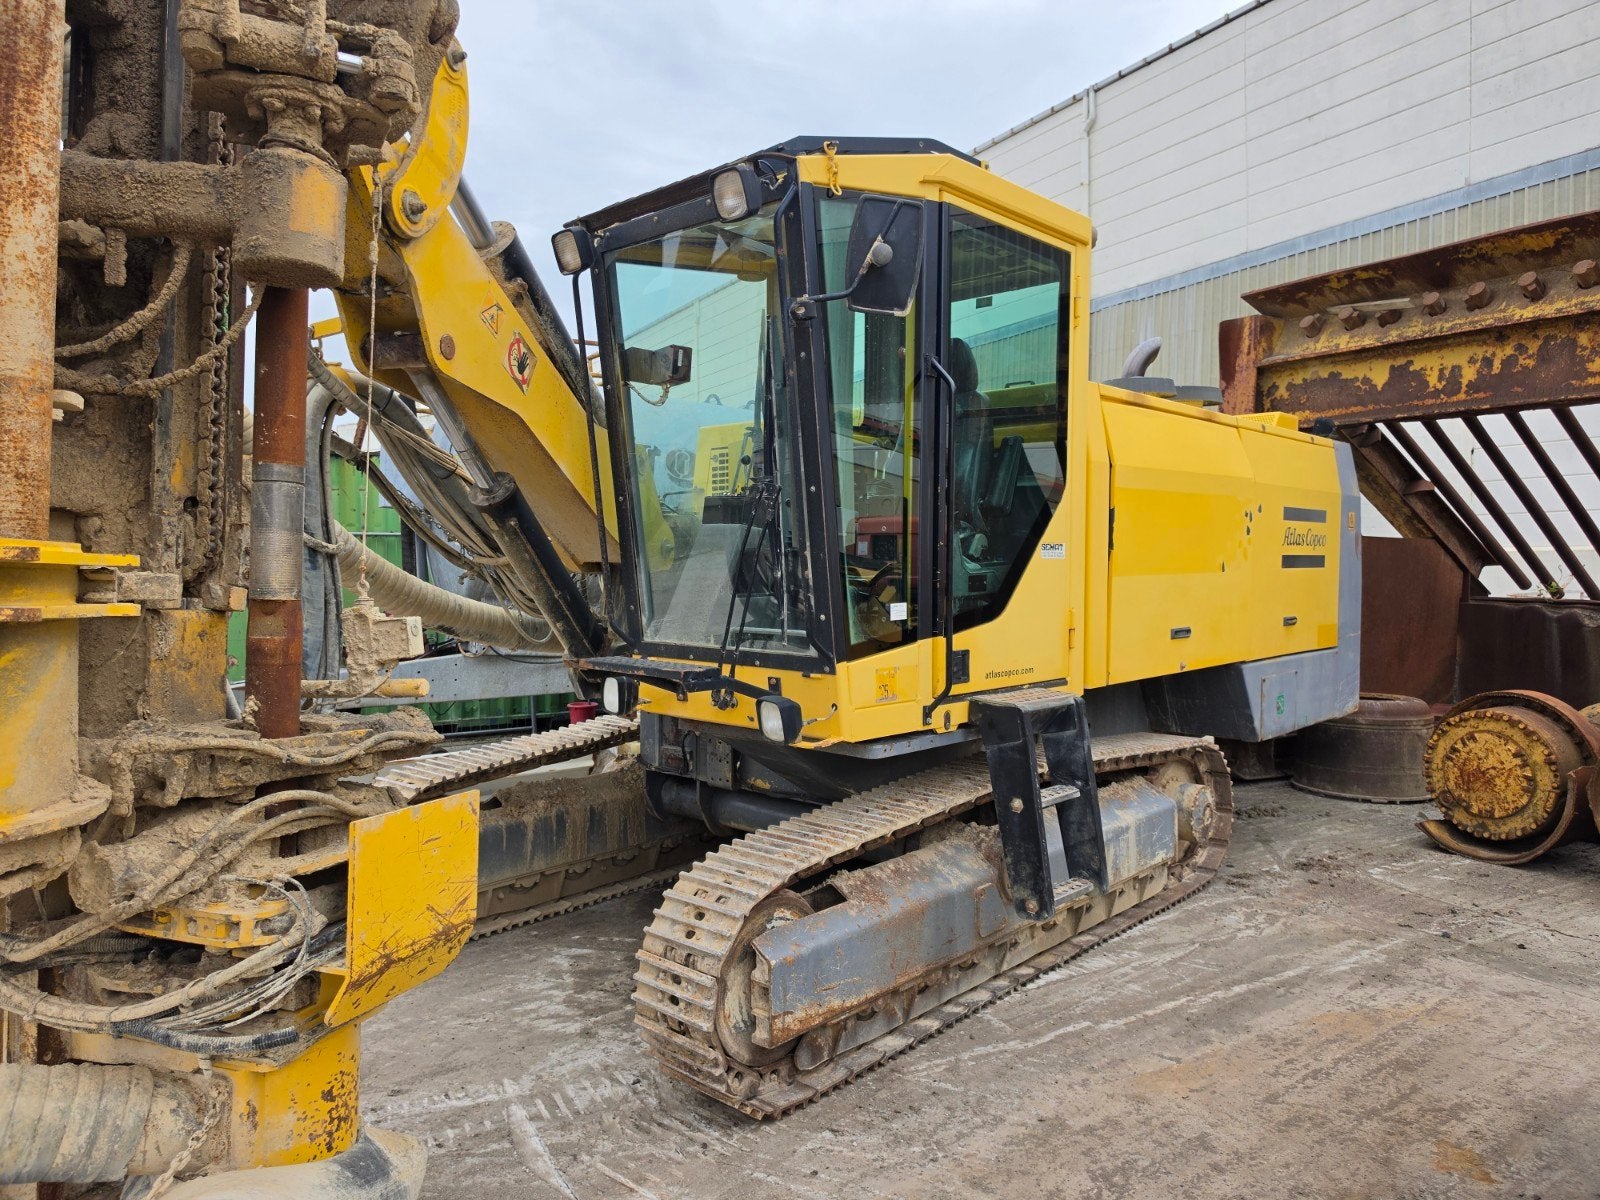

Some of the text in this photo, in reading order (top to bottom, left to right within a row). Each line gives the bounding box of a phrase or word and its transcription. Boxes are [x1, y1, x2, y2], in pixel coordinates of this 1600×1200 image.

[1283, 527, 1327, 550] Atlas Copco
[985, 667, 1034, 680] atlascopco.com
